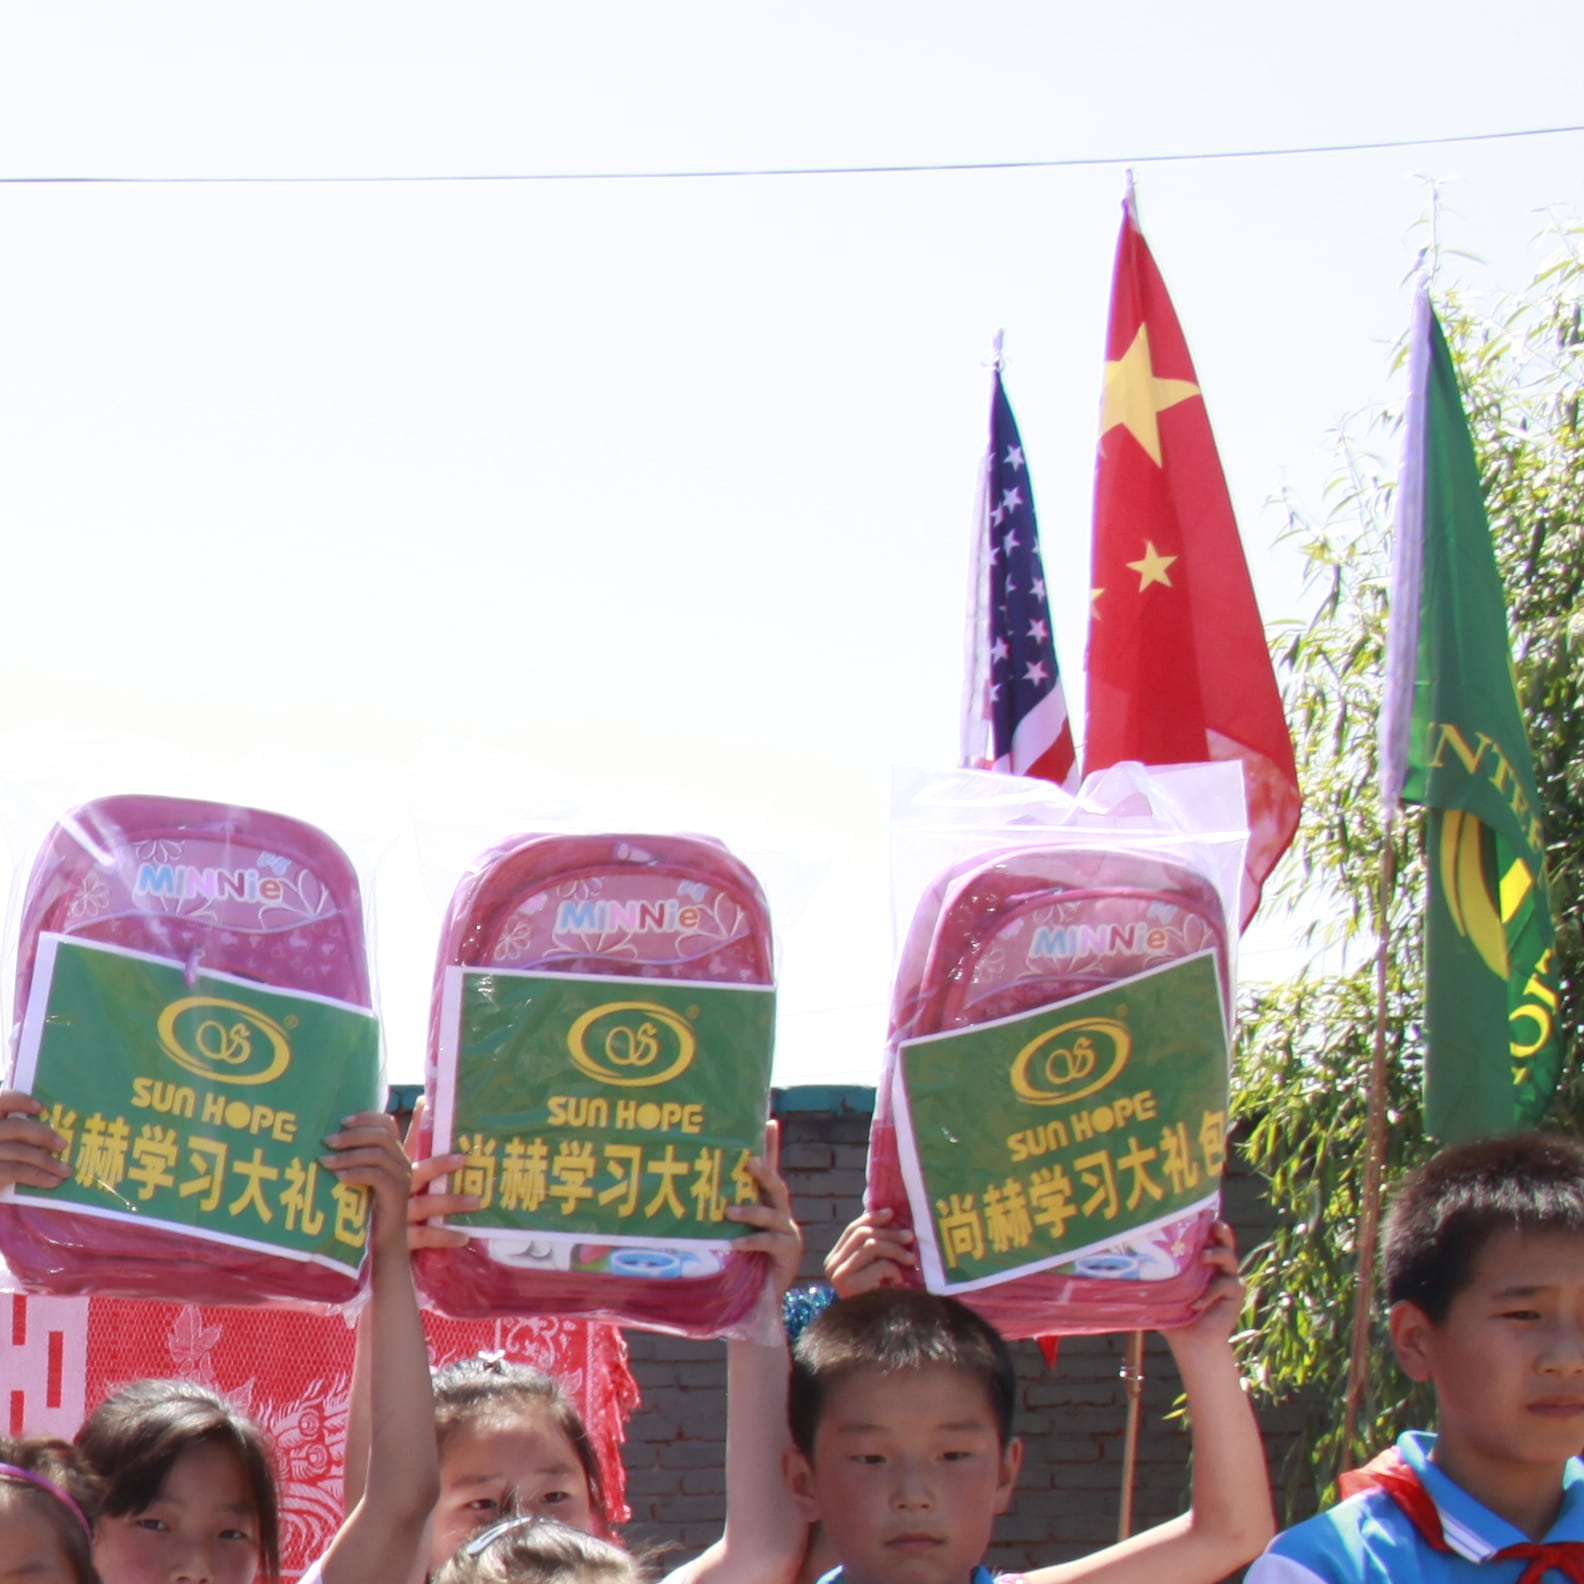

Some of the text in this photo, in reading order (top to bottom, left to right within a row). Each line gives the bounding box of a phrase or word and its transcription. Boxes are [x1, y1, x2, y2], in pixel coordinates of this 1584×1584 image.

[134, 1079, 295, 1147] SUN HOPE
[549, 1096, 703, 1132] SUN HOPE
[1007, 1086, 1156, 1162] SUN HOPE
